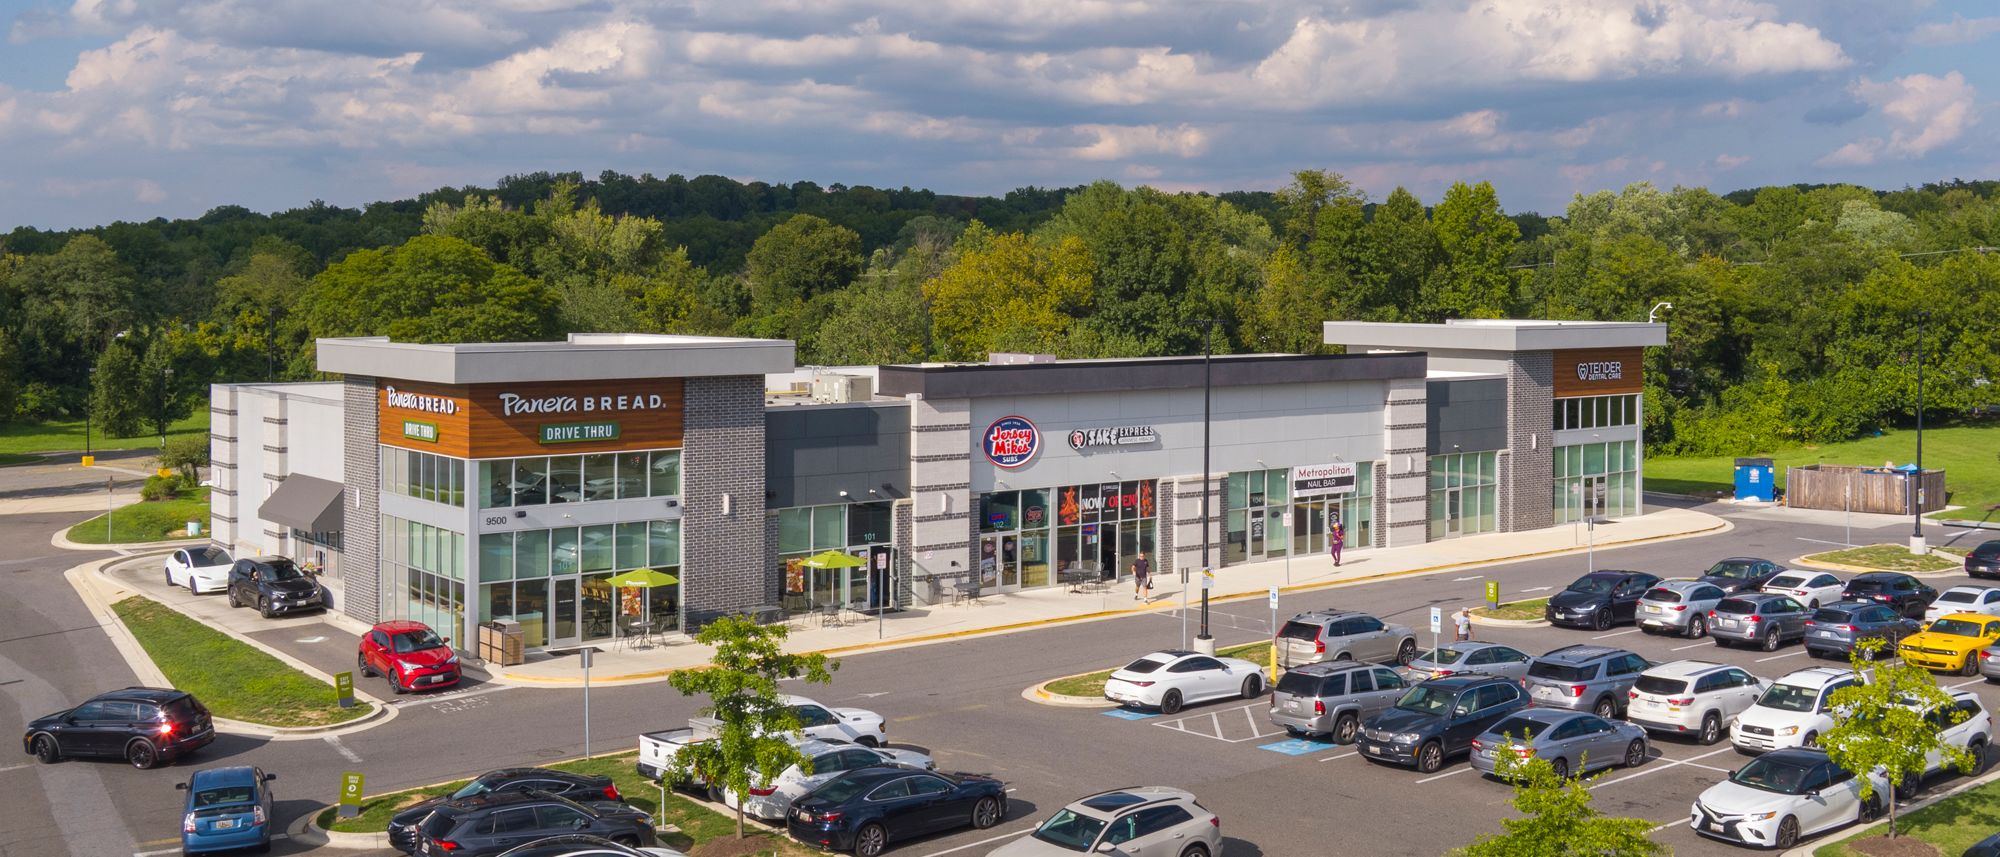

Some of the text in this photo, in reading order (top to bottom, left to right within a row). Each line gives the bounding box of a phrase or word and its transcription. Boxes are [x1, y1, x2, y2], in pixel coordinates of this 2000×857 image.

[386, 385, 418, 409] Panera
[499, 393, 577, 416] Panera
[405, 422, 434, 439] DRIVE THRU
[546, 424, 613, 440] DRIVE THRU
[990, 426, 1032, 443] Jersey
[1087, 426, 1154, 446] SAKE EXPRESS
[1298, 465, 1351, 478] Metropolitan
[1307, 479, 1336, 488] NAIL BAR
[1081, 496, 1106, 510] NOW
[486, 516, 507, 526] 9500
[864, 532, 876, 541] 101
